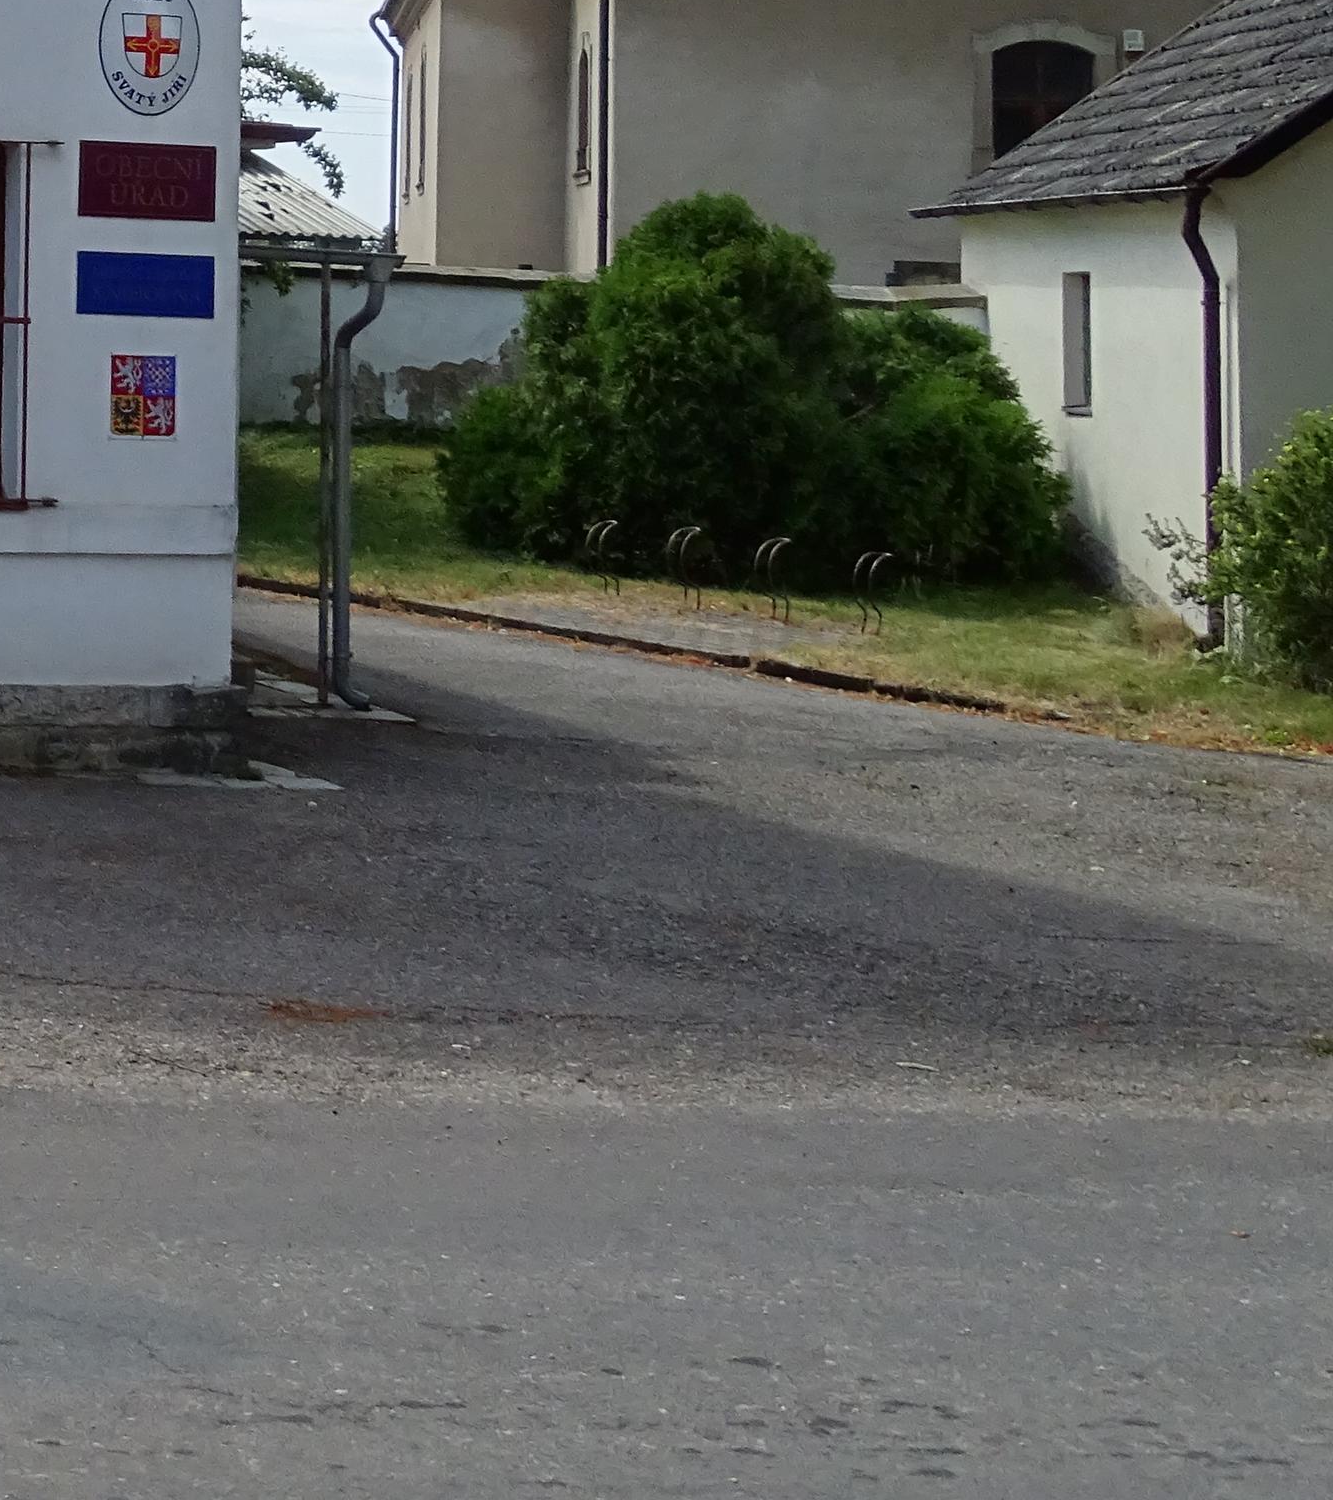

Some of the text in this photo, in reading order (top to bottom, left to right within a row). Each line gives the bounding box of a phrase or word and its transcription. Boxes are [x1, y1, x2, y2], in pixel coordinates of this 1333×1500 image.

[111, 70, 188, 107] SVATÝ JIŘÍ
[95, 153, 203, 180] OBECNÍ
